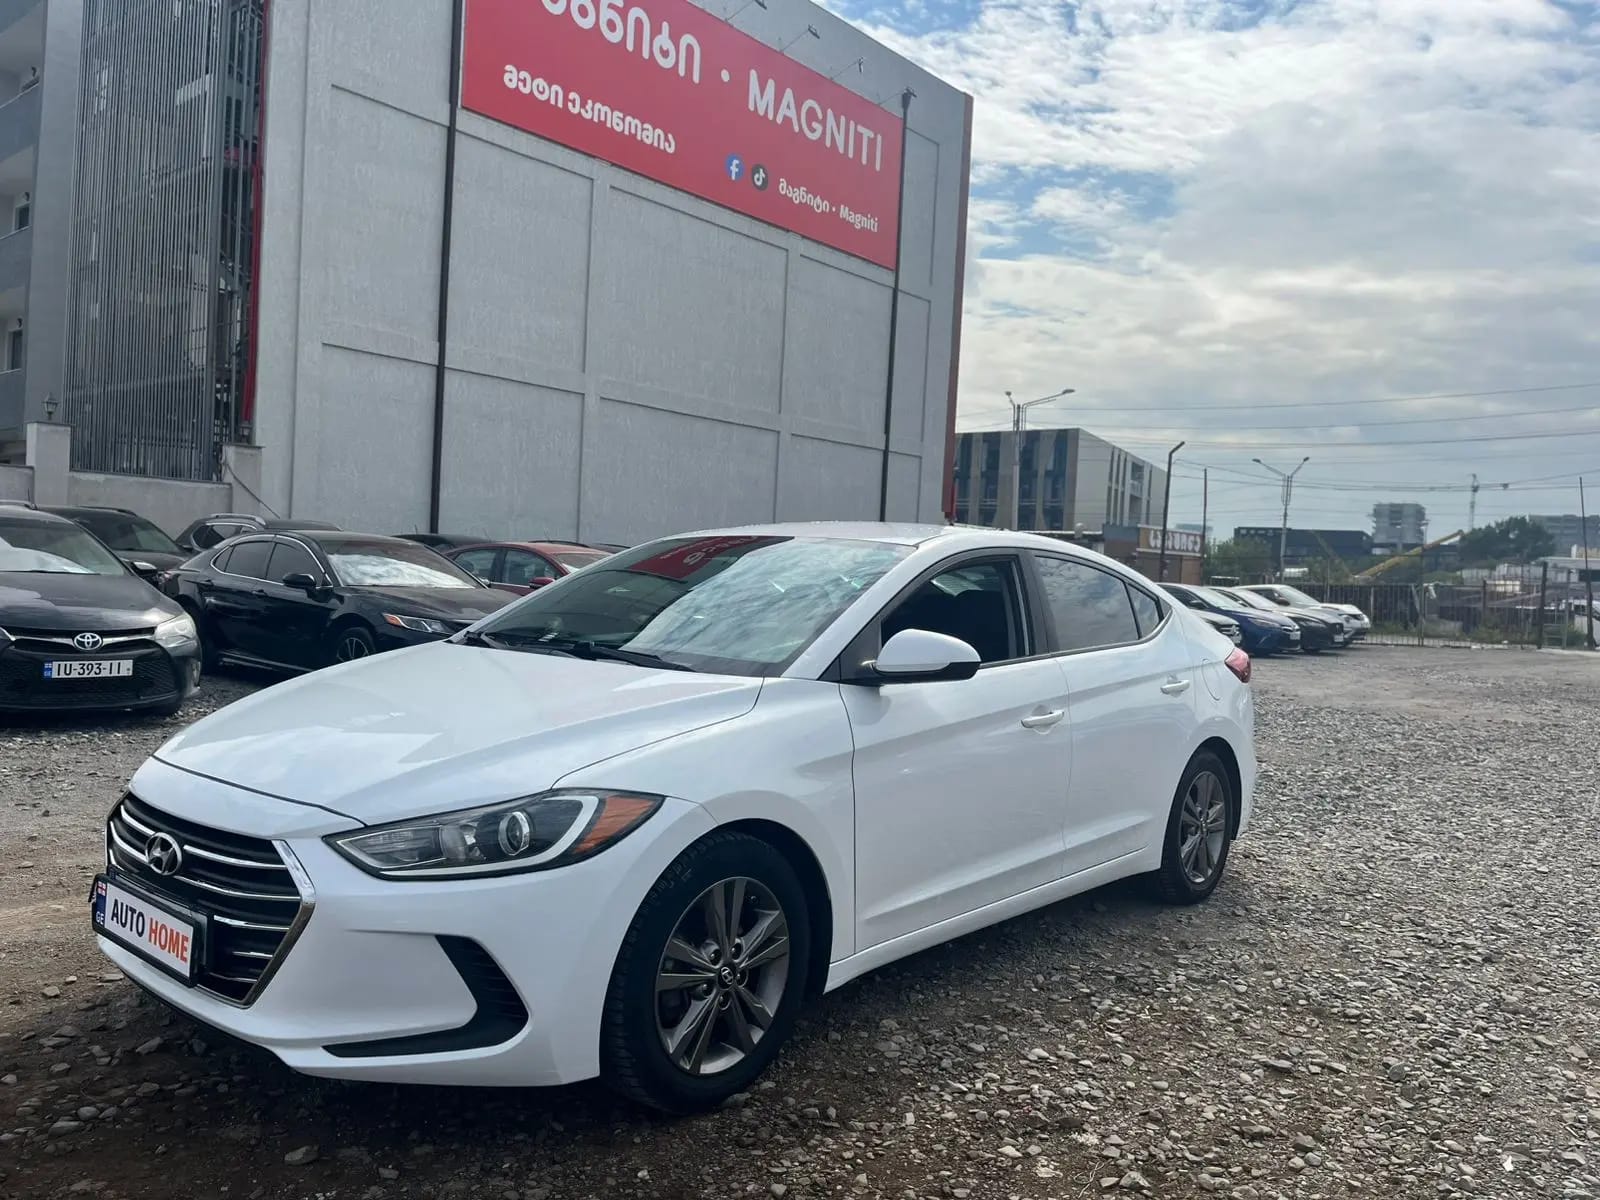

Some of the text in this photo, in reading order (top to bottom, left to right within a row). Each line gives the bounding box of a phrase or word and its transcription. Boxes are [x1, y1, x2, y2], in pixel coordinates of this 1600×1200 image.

[503, 64, 676, 154] მეტი ეკონომია
[747, 69, 883, 172] MAGNITI
[778, 177, 830, 213] მაგნიტი
[839, 204, 879, 233] Magniti
[111, 899, 189, 963] AUTO HOME
